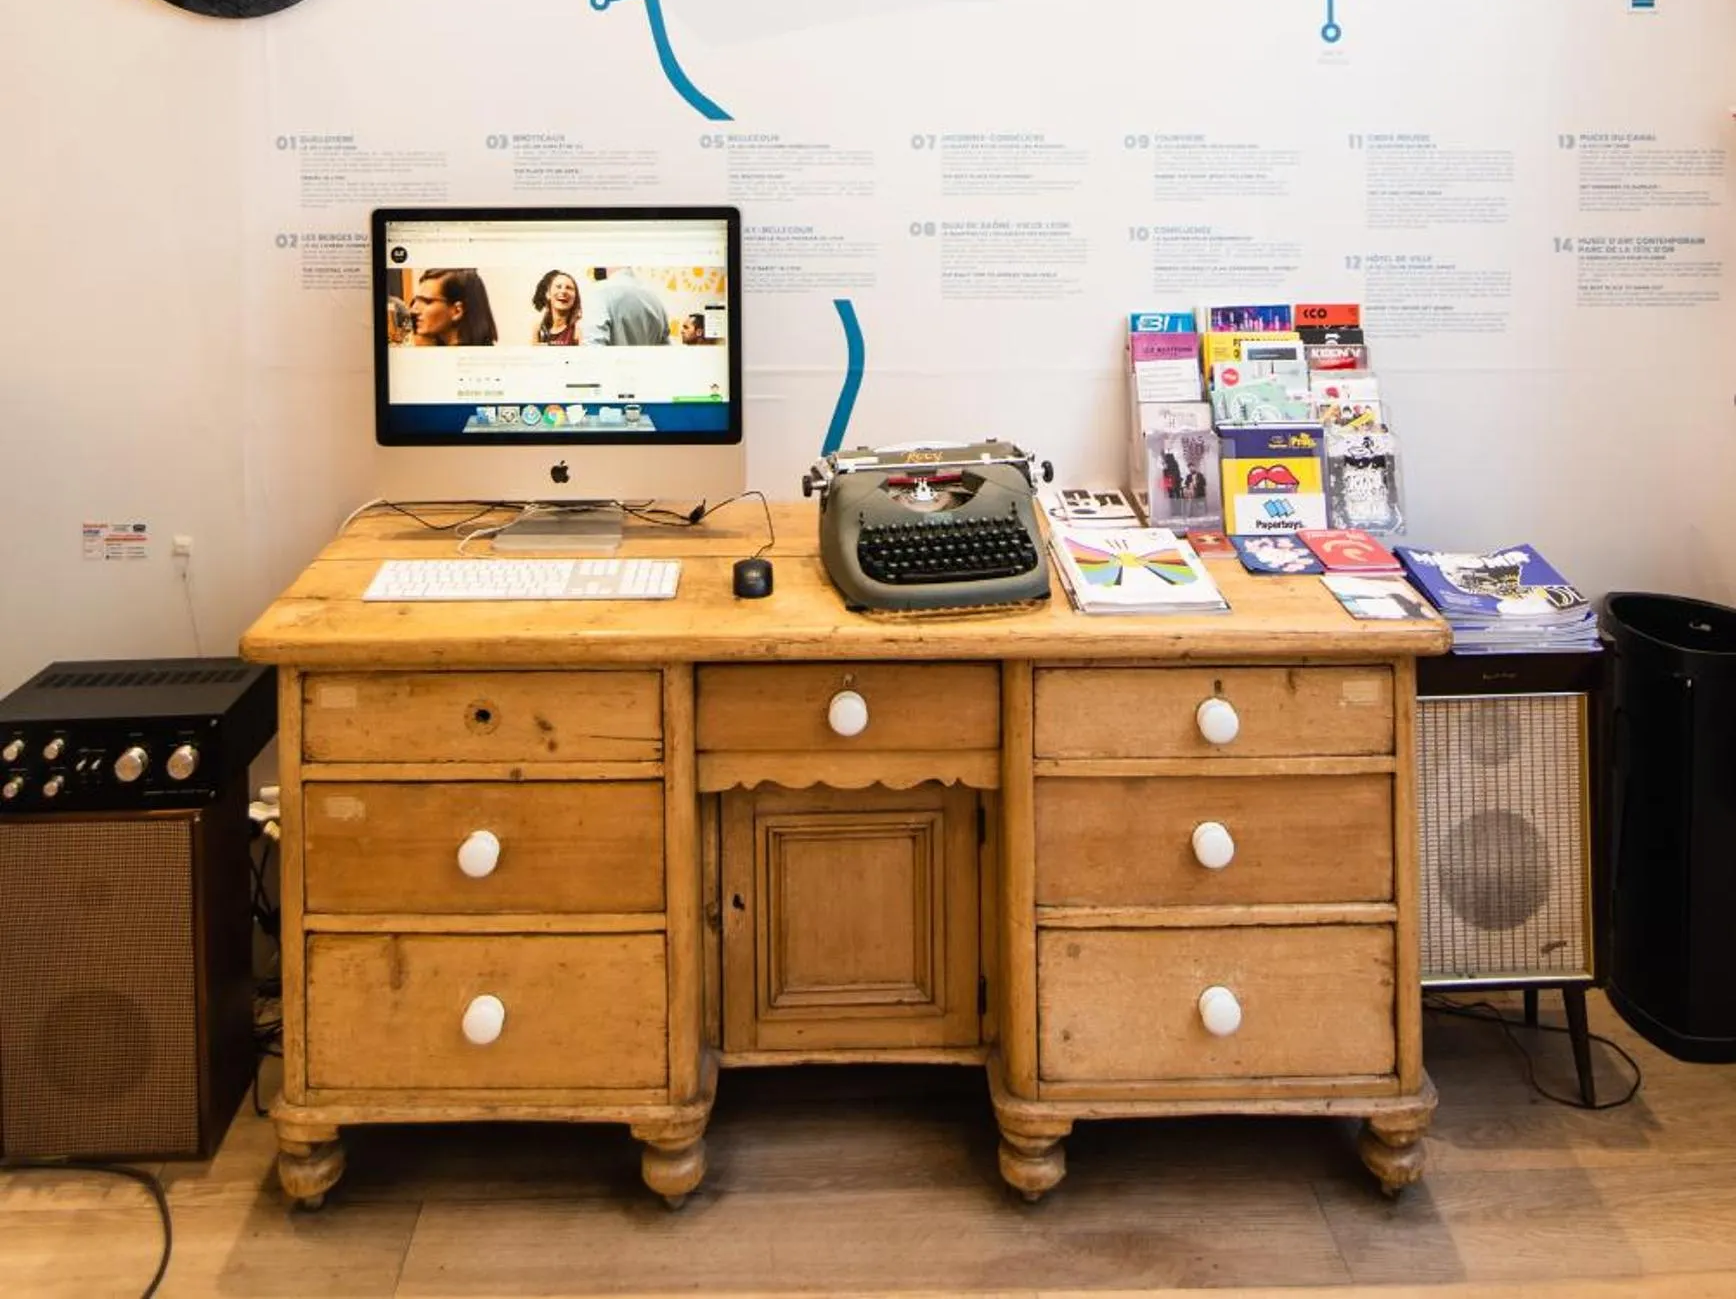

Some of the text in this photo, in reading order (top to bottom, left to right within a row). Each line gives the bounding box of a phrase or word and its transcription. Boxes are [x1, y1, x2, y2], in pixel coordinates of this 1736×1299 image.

[486, 134, 509, 150] 03
[699, 134, 724, 149] 05
[910, 134, 937, 151] 07
[1124, 134, 1150, 150] 09
[1128, 226, 1150, 241] 10
[275, 234, 298, 249] 02
[1345, 255, 1361, 270] 12
